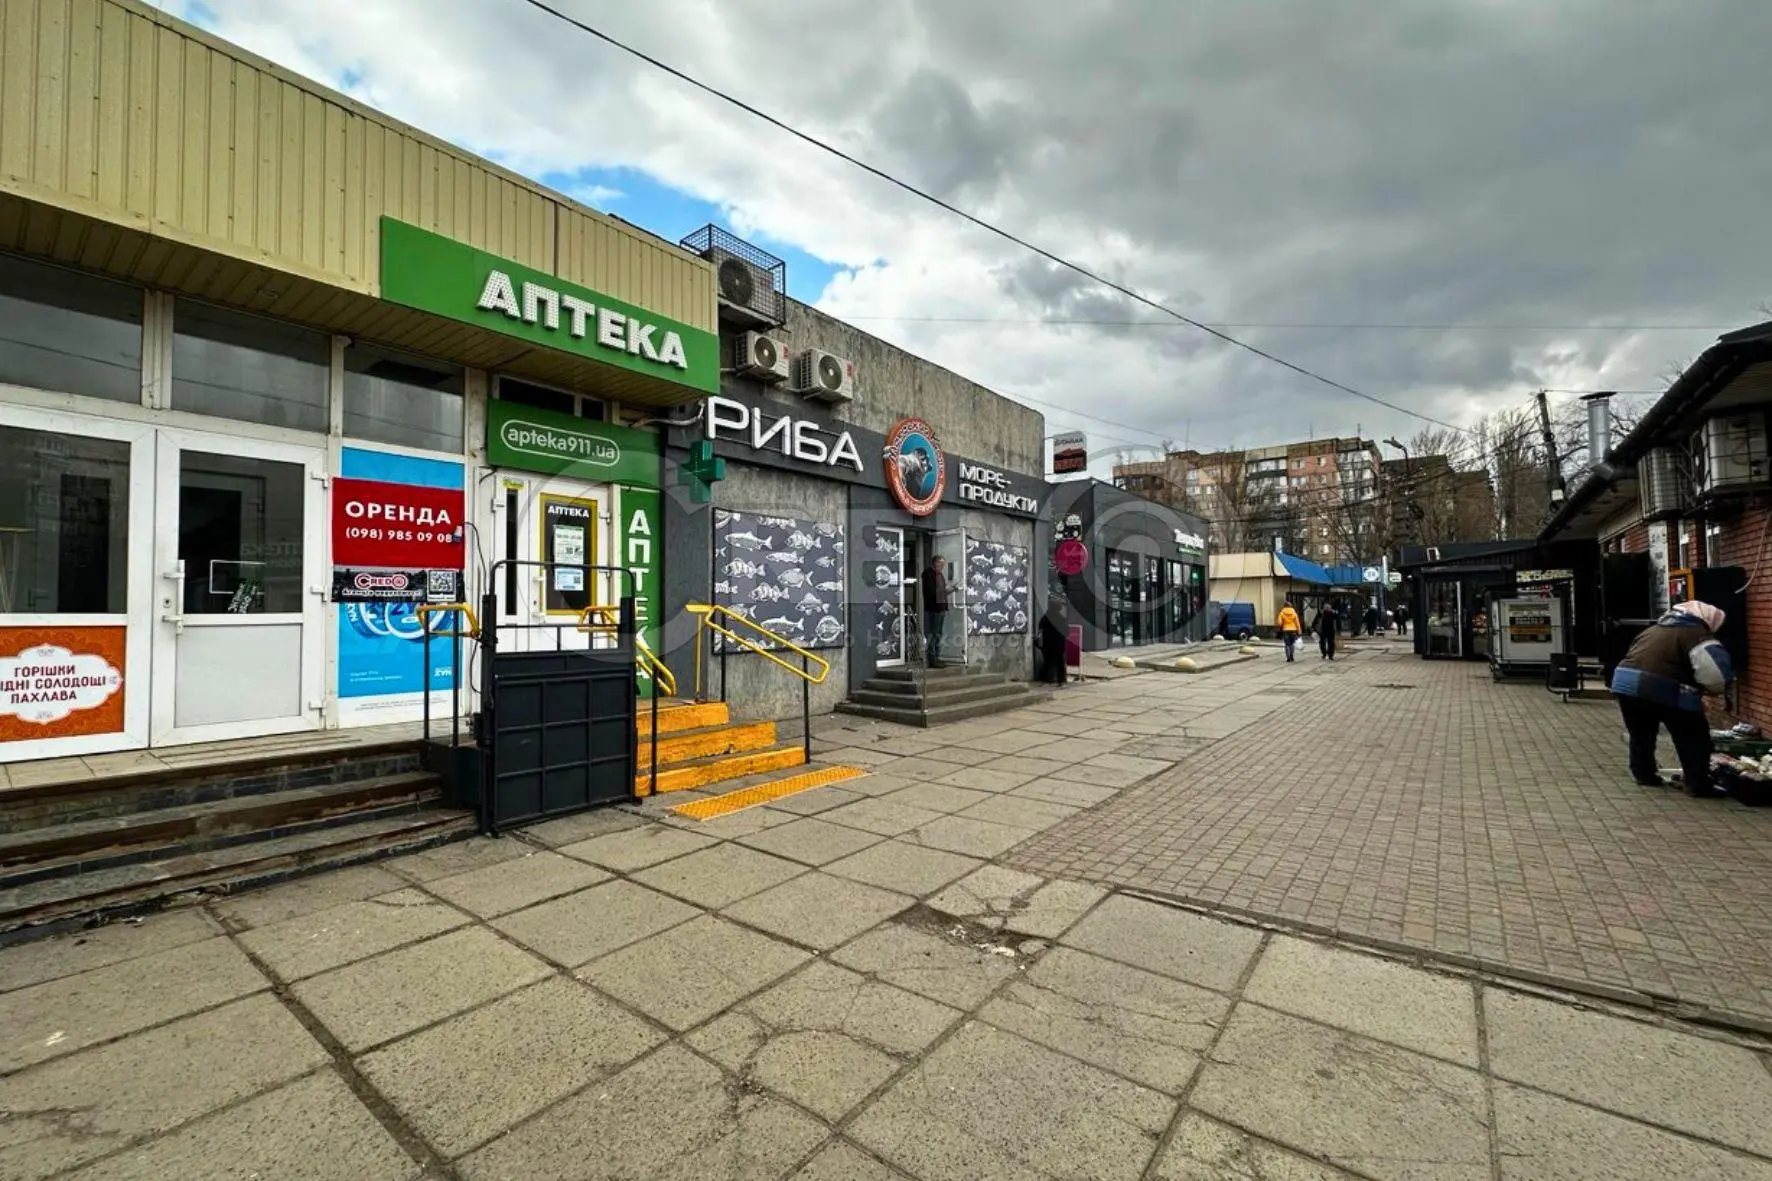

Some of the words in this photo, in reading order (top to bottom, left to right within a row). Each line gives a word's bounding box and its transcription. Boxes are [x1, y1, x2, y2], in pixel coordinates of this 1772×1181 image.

[477, 269, 688, 369] АПТЕКА
[507, 426, 615, 460] apteka911.ua
[707, 395, 865, 472] РИБА
[959, 462, 1012, 489] МОРЕ-
[547, 504, 590, 518] АПТЕКА
[959, 483, 1038, 514] ПРОДУКТИ
[345, 500, 452, 527] ОРЕНДА
[345, 526, 383, 541] (098)
[388, 529, 413, 541] 985
[417, 532, 433, 543] 09
[437, 533, 453, 544] 08
[14, 664, 76, 678] ГОРІШКИ
[35, 676, 106, 690] СОЛОДОЩІ
[10, 690, 77, 704] ПАХЛАВА
